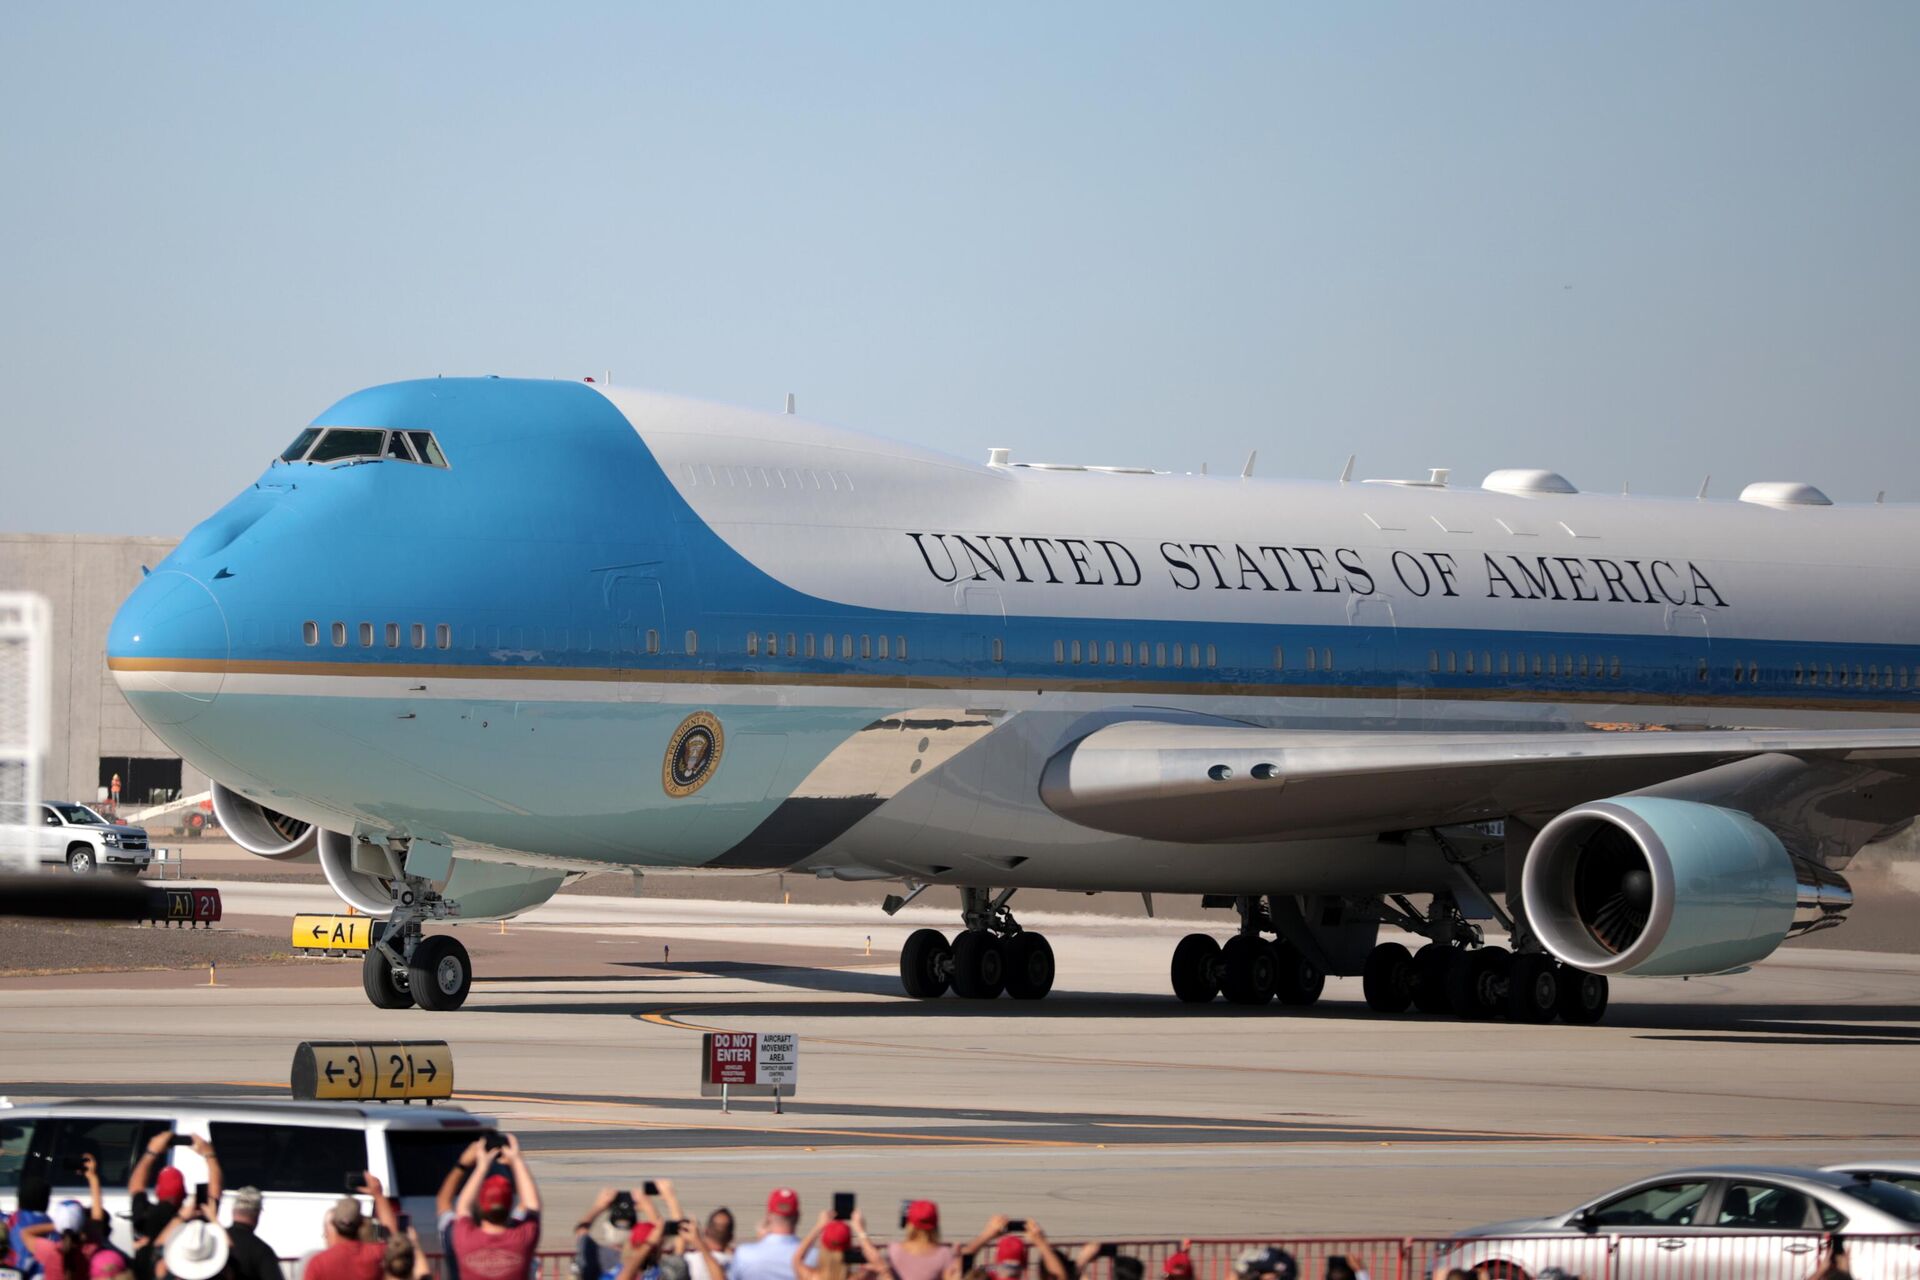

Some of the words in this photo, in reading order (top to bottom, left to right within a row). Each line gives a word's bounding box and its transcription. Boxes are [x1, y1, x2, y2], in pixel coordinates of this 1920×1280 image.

[905, 532, 1142, 586] UNITED
[1159, 541, 1375, 595] STATES
[1391, 550, 1460, 597] OF
[1484, 552, 1730, 607] AMERICA
[668, 716, 701, 756] PRESIDENT
[174, 895, 189, 916] A1
[200, 896, 216, 916] 21
[331, 922, 355, 943] A1
[714, 1034, 730, 1048] DO
[732, 1034, 755, 1048] NOT
[763, 1034, 792, 1043] AIRCRAFT
[716, 1048, 751, 1062] ENTER
[761, 1044, 794, 1052] MOVEMENT
[769, 1053, 785, 1062] AREA
[348, 1055, 362, 1088] 3
[390, 1054, 415, 1088] 21
